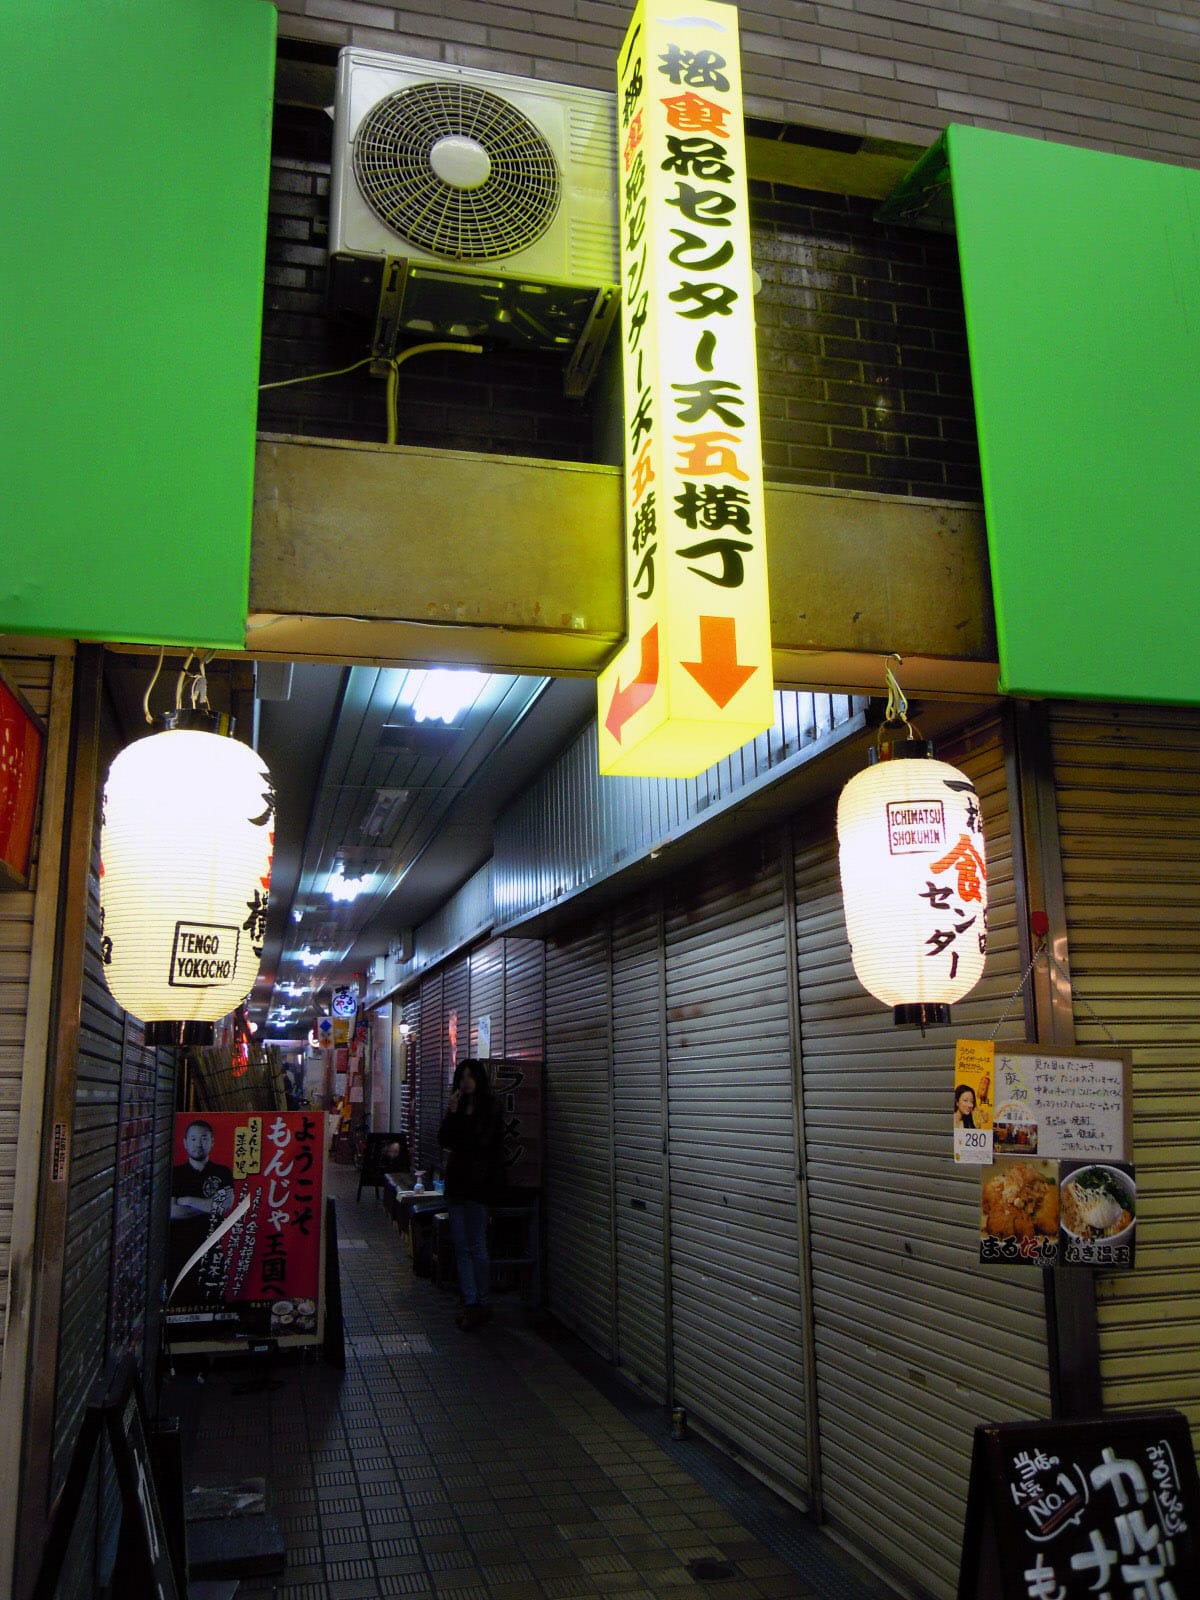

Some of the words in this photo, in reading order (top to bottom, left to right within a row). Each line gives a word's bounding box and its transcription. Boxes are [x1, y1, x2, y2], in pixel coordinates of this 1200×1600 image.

[890, 808, 941, 828] ICHIMATSU
[892, 829, 941, 847] SHOKUHIN
[918, 881, 977, 980] センター
[180, 932, 219, 955] TENGO
[177, 957, 231, 979] YOKOCHO
[965, 1133, 987, 1148] 280
[291, 1117, 316, 1235] ようこそ
